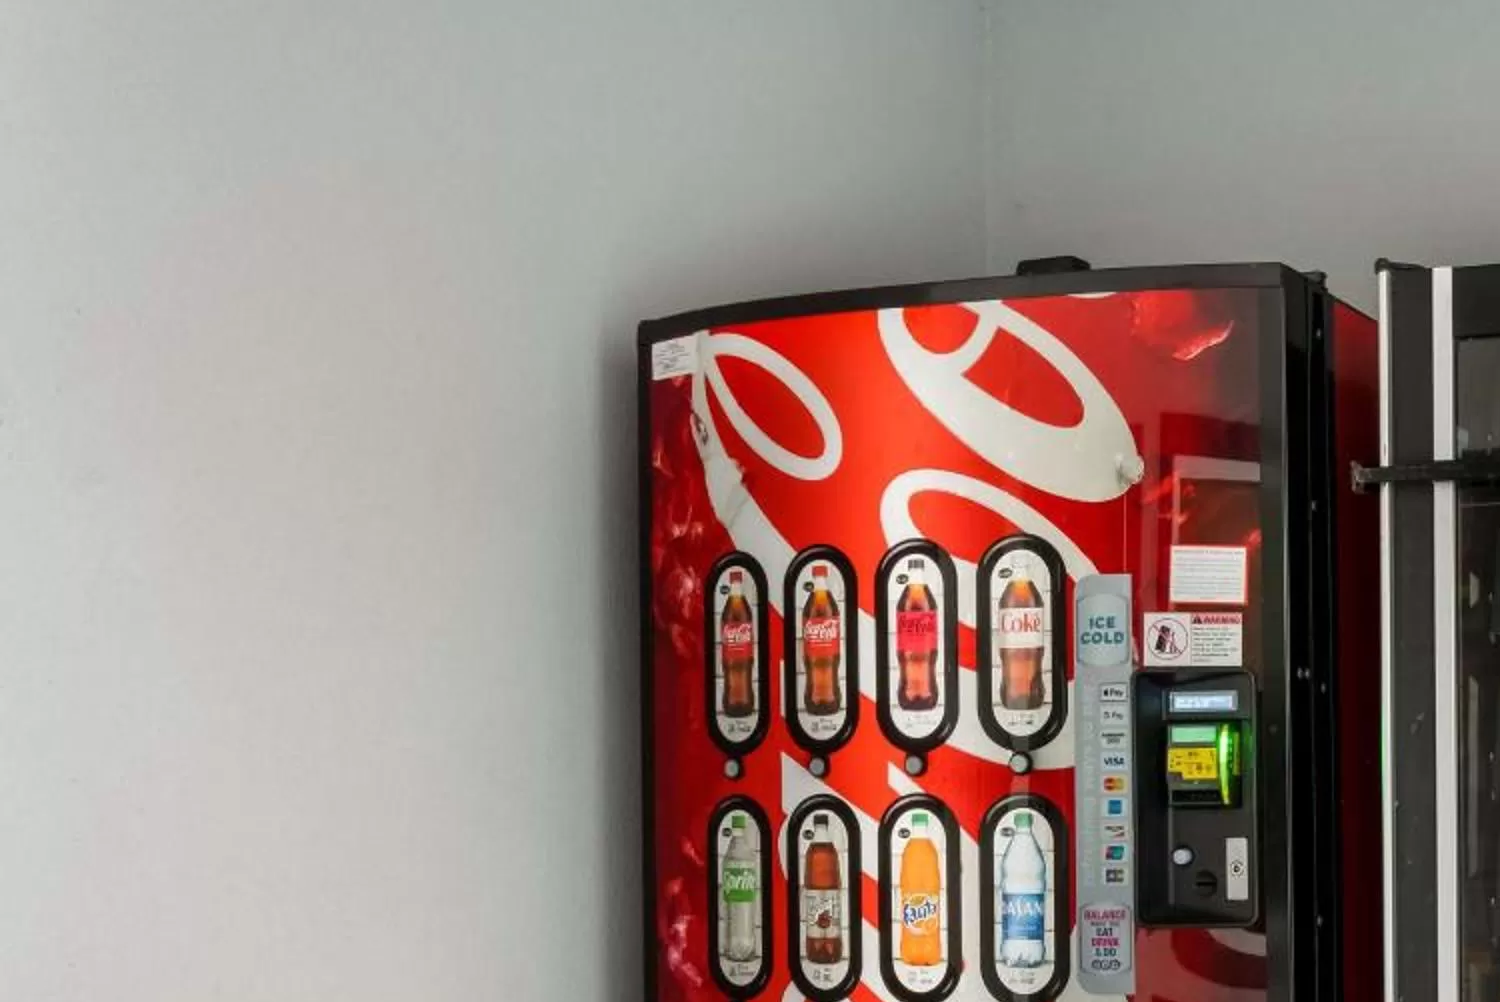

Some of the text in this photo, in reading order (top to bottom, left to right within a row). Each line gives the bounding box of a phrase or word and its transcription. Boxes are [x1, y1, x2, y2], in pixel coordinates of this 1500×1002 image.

[1001, 612, 1041, 633] Coke
[1089, 616, 1116, 630] ICE
[1080, 632, 1125, 645] COLD
[1103, 756, 1125, 766] VISA
[1095, 927, 1113, 937] EAT
[1103, 947, 1117, 957] DO
